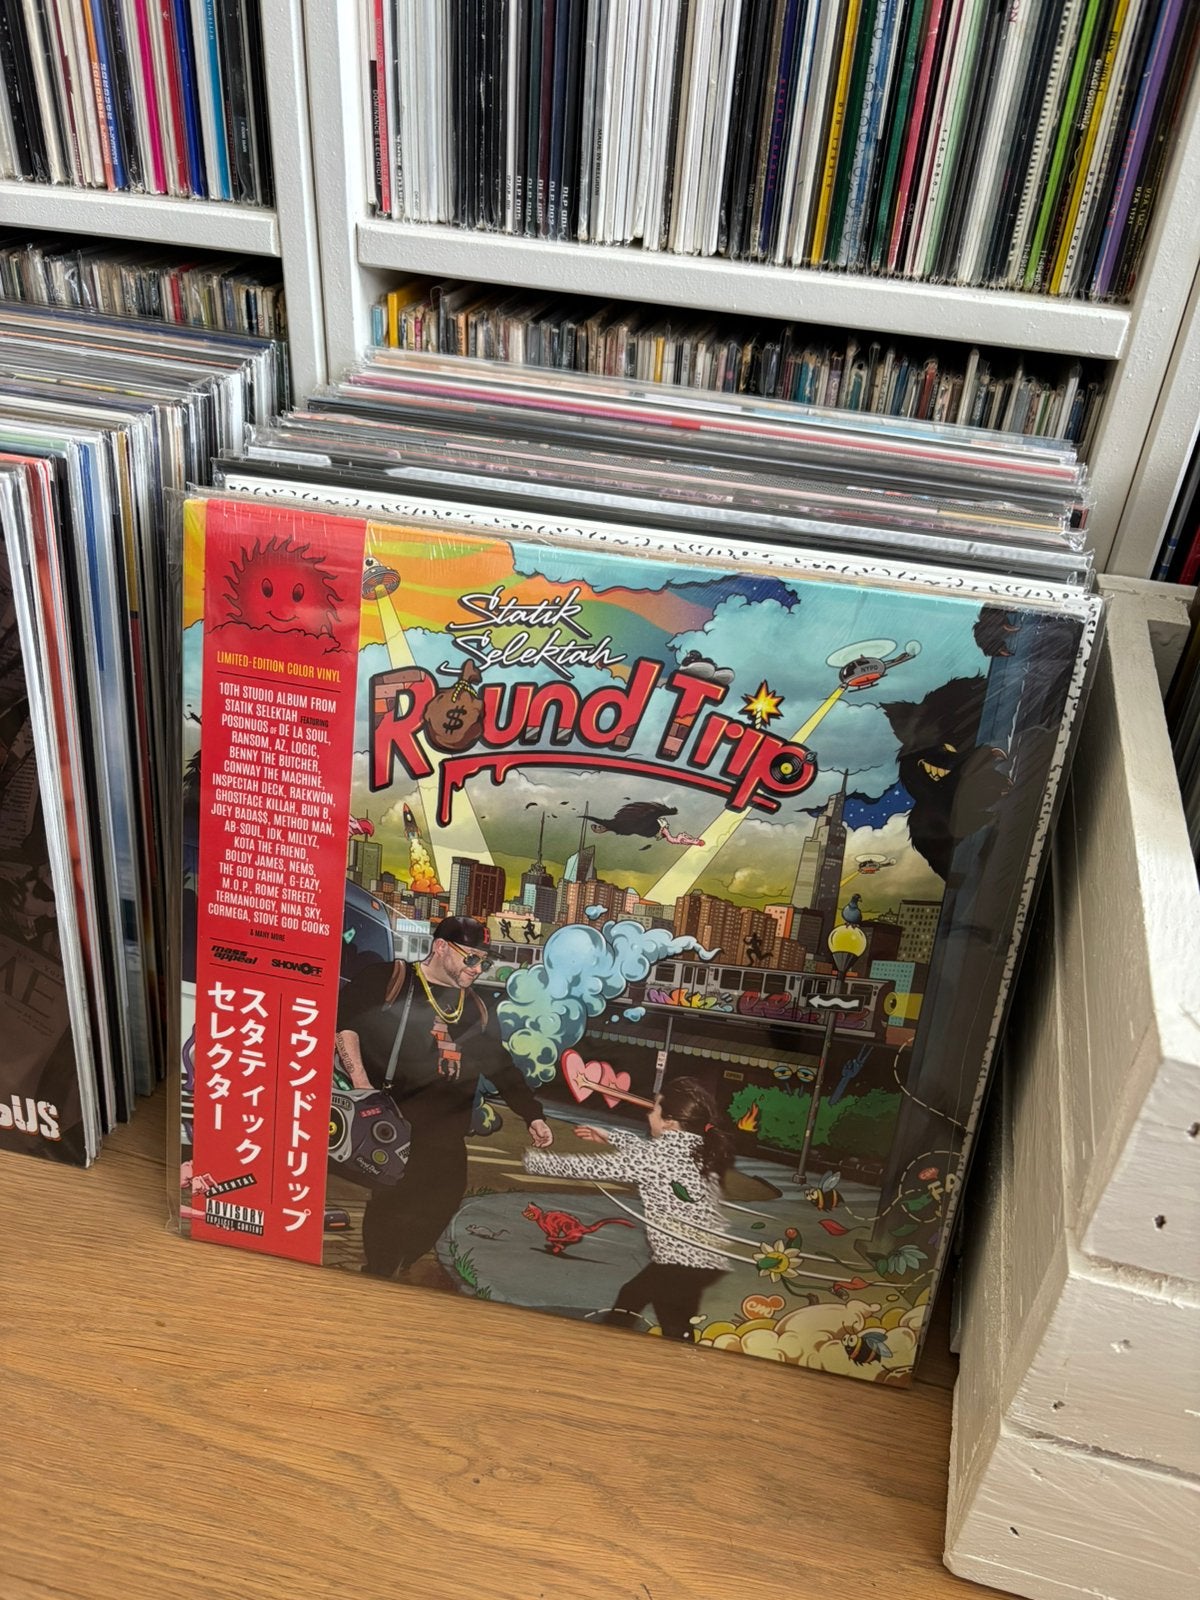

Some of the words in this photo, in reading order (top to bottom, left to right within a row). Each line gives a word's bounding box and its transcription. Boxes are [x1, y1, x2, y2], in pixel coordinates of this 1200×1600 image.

[375, 138, 383, 187] ELECTRICITY
[445, 585, 591, 638] Statik
[217, 651, 284, 672] LIMITED-EDITION
[287, 663, 314, 676] COLOR
[317, 667, 341, 683] VINYL
[437, 628, 627, 679] Selektah
[219, 682, 240, 697] 10TH
[243, 686, 273, 703] STUDIO
[277, 692, 307, 708] ALBUM
[311, 698, 336, 713] FROM
[225, 699, 252, 715] STATIK
[256, 706, 297, 722] SELEKTAH
[300, 716, 329, 727] FEATURING
[222, 714, 268, 733] POSDNUOS
[279, 724, 289, 736] DE
[293, 727, 303, 739] LA
[306, 730, 331, 745] SOUL,
[232, 731, 272, 750] RANSOM,
[275, 739, 288, 753] AZ,
[291, 742, 319, 759] LOGIC,
[369, 659, 663, 792] Round
[655, 671, 818, 812] Trip
[224, 760, 260, 778] CONWAY
[264, 767, 279, 781] THE
[282, 771, 325, 790] MACHINE,
[230, 746, 257, 762] BENNY
[261, 752, 276, 766] THE
[279, 755, 321, 774] BUTCHER,
[213, 774, 258, 792] INSPECTAH
[262, 782, 287, 798] DECK,
[290, 787, 336, 807] RAEKWON,
[216, 789, 262, 808] GHOSTFACE
[266, 798, 298, 815] KILLAH,
[302, 805, 319, 817] BUN
[323, 808, 331, 820] B,
[211, 803, 232, 817] JOEY
[274, 814, 308, 830] METHOD
[312, 821, 335, 837] MAN,
[225, 821, 264, 839] AB-SOUL,
[267, 829, 284, 843] IDK,
[288, 832, 319, 849] MILLYZ,
[226, 849, 252, 864] BOLDY
[255, 856, 286, 873] JAMES,
[289, 861, 316, 877] NEMS,
[234, 836, 255, 850] KOTA
[258, 841, 272, 854] THE
[276, 844, 309, 861] FRIEND,
[219, 862, 233, 875] THE
[237, 866, 253, 879] GOD
[257, 870, 286, 887] FAHIM,
[290, 876, 321, 893] G-EAZY,
[222, 878, 252, 894] M.O.P.,
[255, 884, 279, 899] ROME
[282, 889, 317, 906] STREETZ,
[208, 903, 250, 923] CORMEGA,
[254, 912, 278, 927] STOVE
[282, 916, 298, 930] GOD
[302, 920, 330, 936] COOKS
[216, 890, 277, 913] TERMANOLOGY,
[281, 903, 302, 917] NINA
[305, 907, 322, 921] SKY,
[255, 930, 269, 939] MANY
[212, 945, 248, 957] mass
[214, 952, 258, 965] appeal
[206, 981, 236, 1131] セレクター
[235, 987, 269, 1165] スタティック
[282, 997, 320, 1232] ラウンドトリップ
[208, 1200, 262, 1224] ADVISORY
